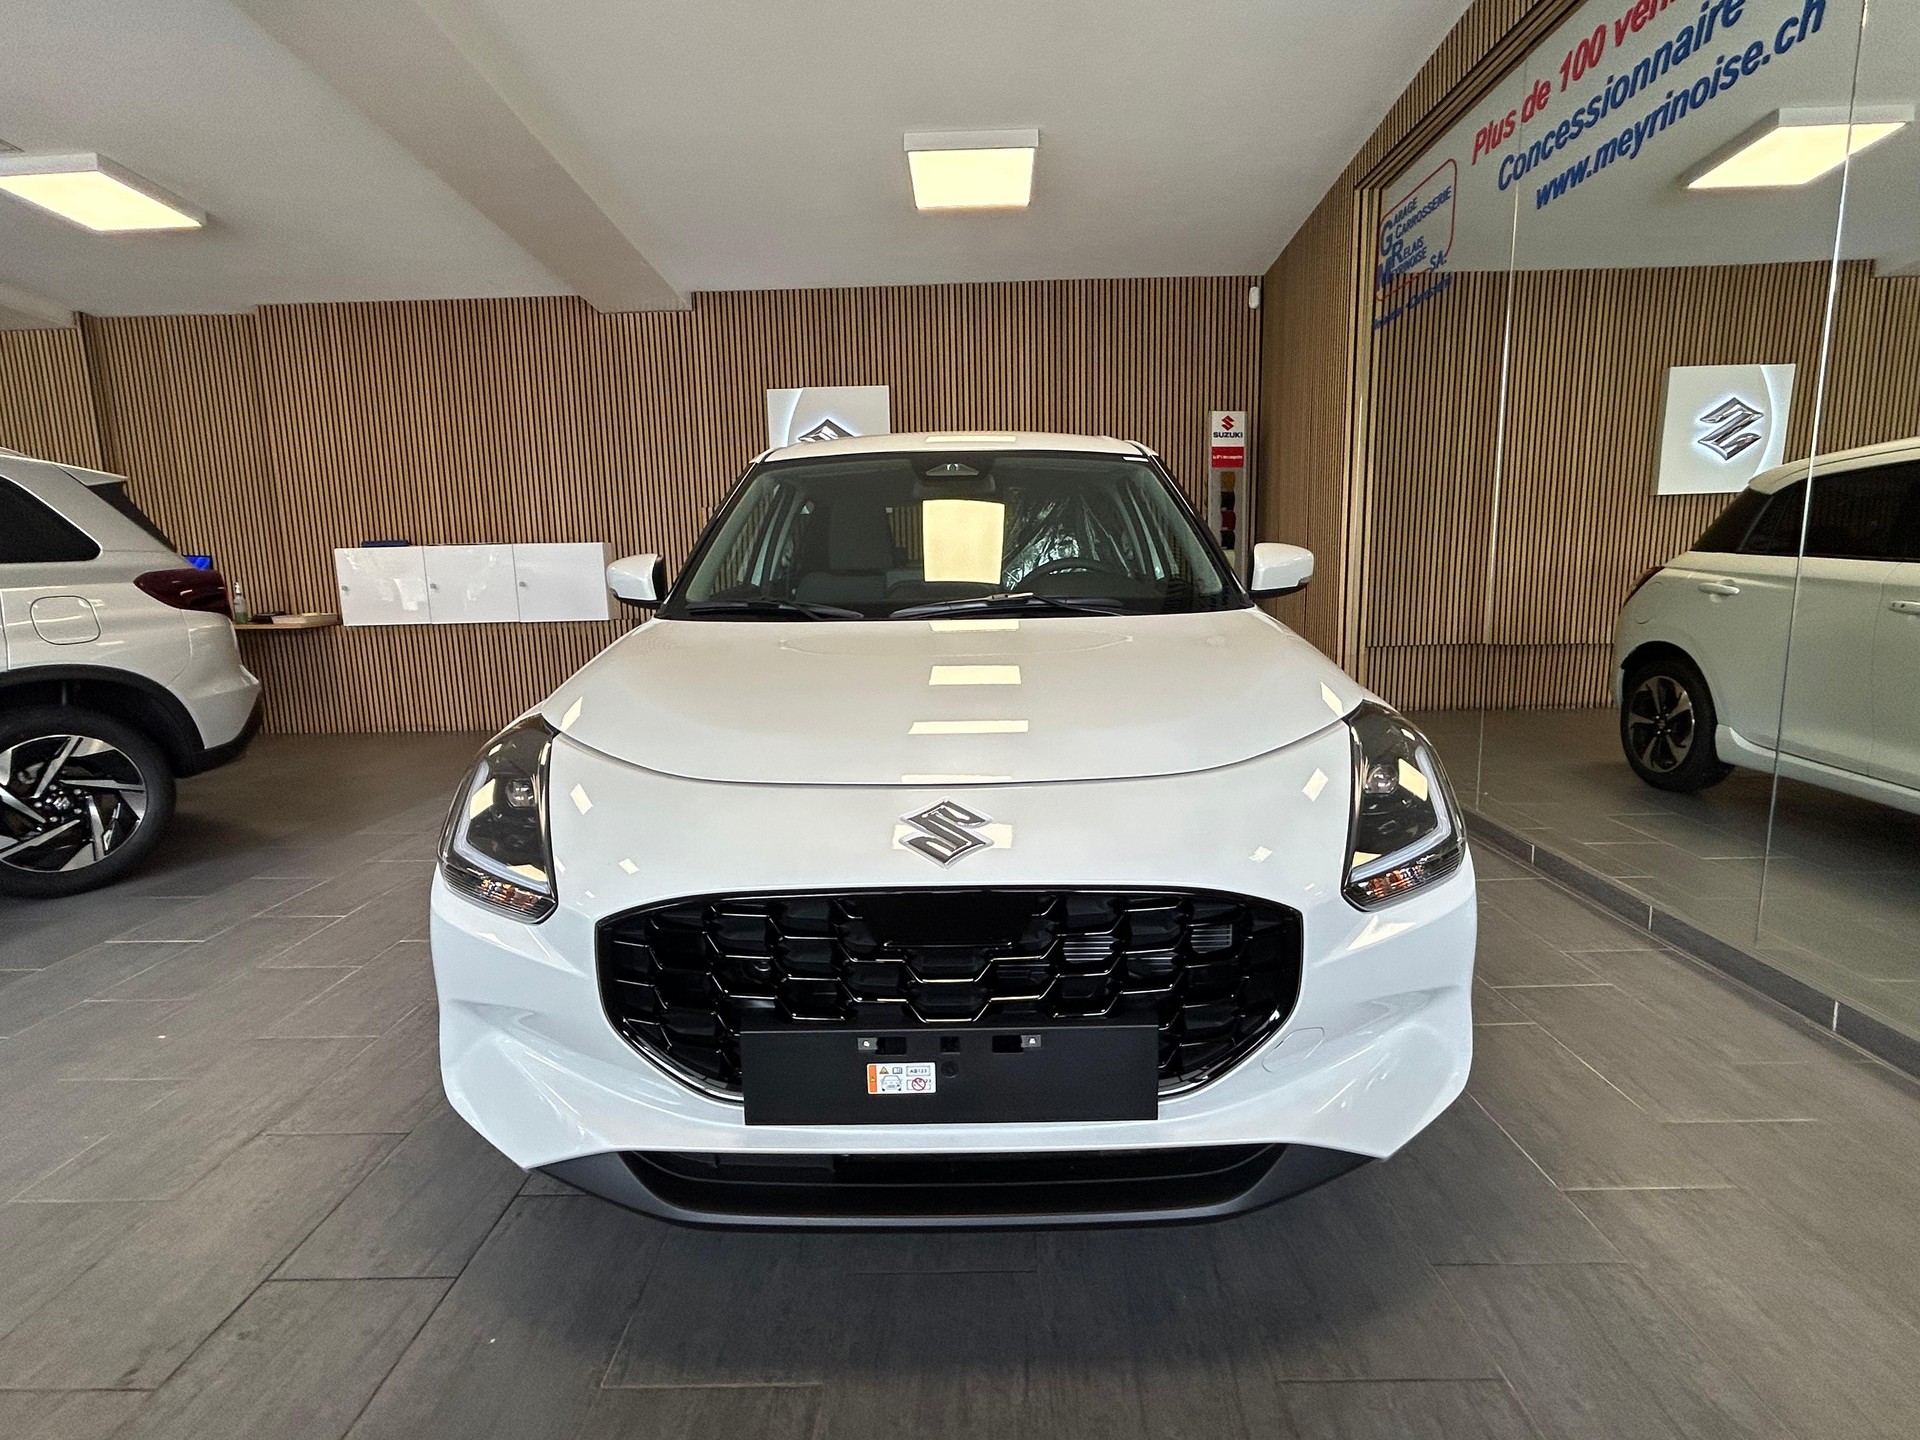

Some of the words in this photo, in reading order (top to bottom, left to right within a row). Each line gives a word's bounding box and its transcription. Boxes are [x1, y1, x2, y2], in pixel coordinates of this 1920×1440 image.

[1472, 109, 1517, 166] Plus
[1521, 79, 1551, 124] de
[1559, 24, 1607, 92] 100
[1498, 0, 1746, 190] Concessionnaire
[1536, 0, 1826, 209] www.meyrinoise.ch
